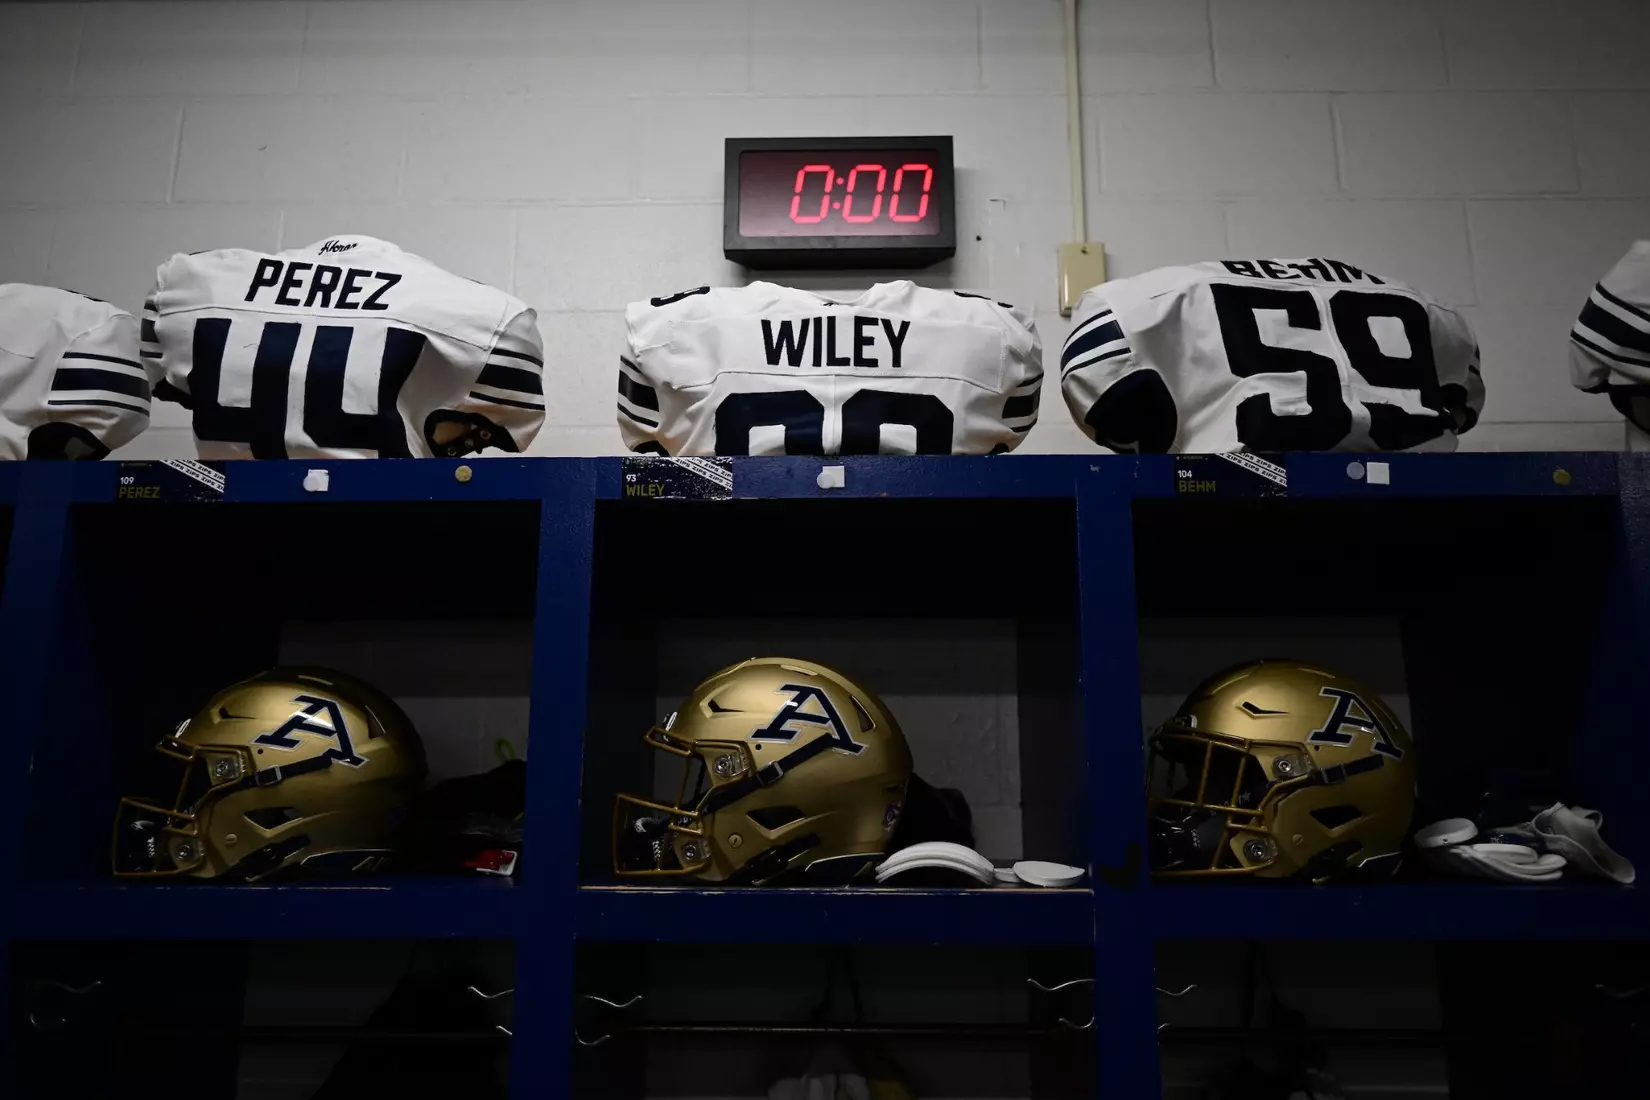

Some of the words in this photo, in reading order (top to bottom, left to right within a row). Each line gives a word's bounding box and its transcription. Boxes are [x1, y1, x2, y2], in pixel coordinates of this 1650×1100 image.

[790, 162, 934, 223] 0:00
[245, 259, 402, 311] PEREZ
[1220, 257, 1386, 285] BEHM
[761, 315, 911, 368] WILEY
[1210, 283, 1440, 451] 59
[186, 317, 426, 459] 44
[120, 476, 135, 485] 109
[185, 468, 200, 478] ZIPS
[626, 473, 637, 482] 93
[1177, 469, 1193, 479] 104
[1244, 461, 1259, 472] ZIPS
[119, 486, 160, 499] PEREZ
[626, 484, 665, 497] WILEY
[1179, 480, 1217, 493] BEHM
[252, 694, 369, 768] A
[750, 683, 867, 756] A
[1307, 686, 1404, 758] A
